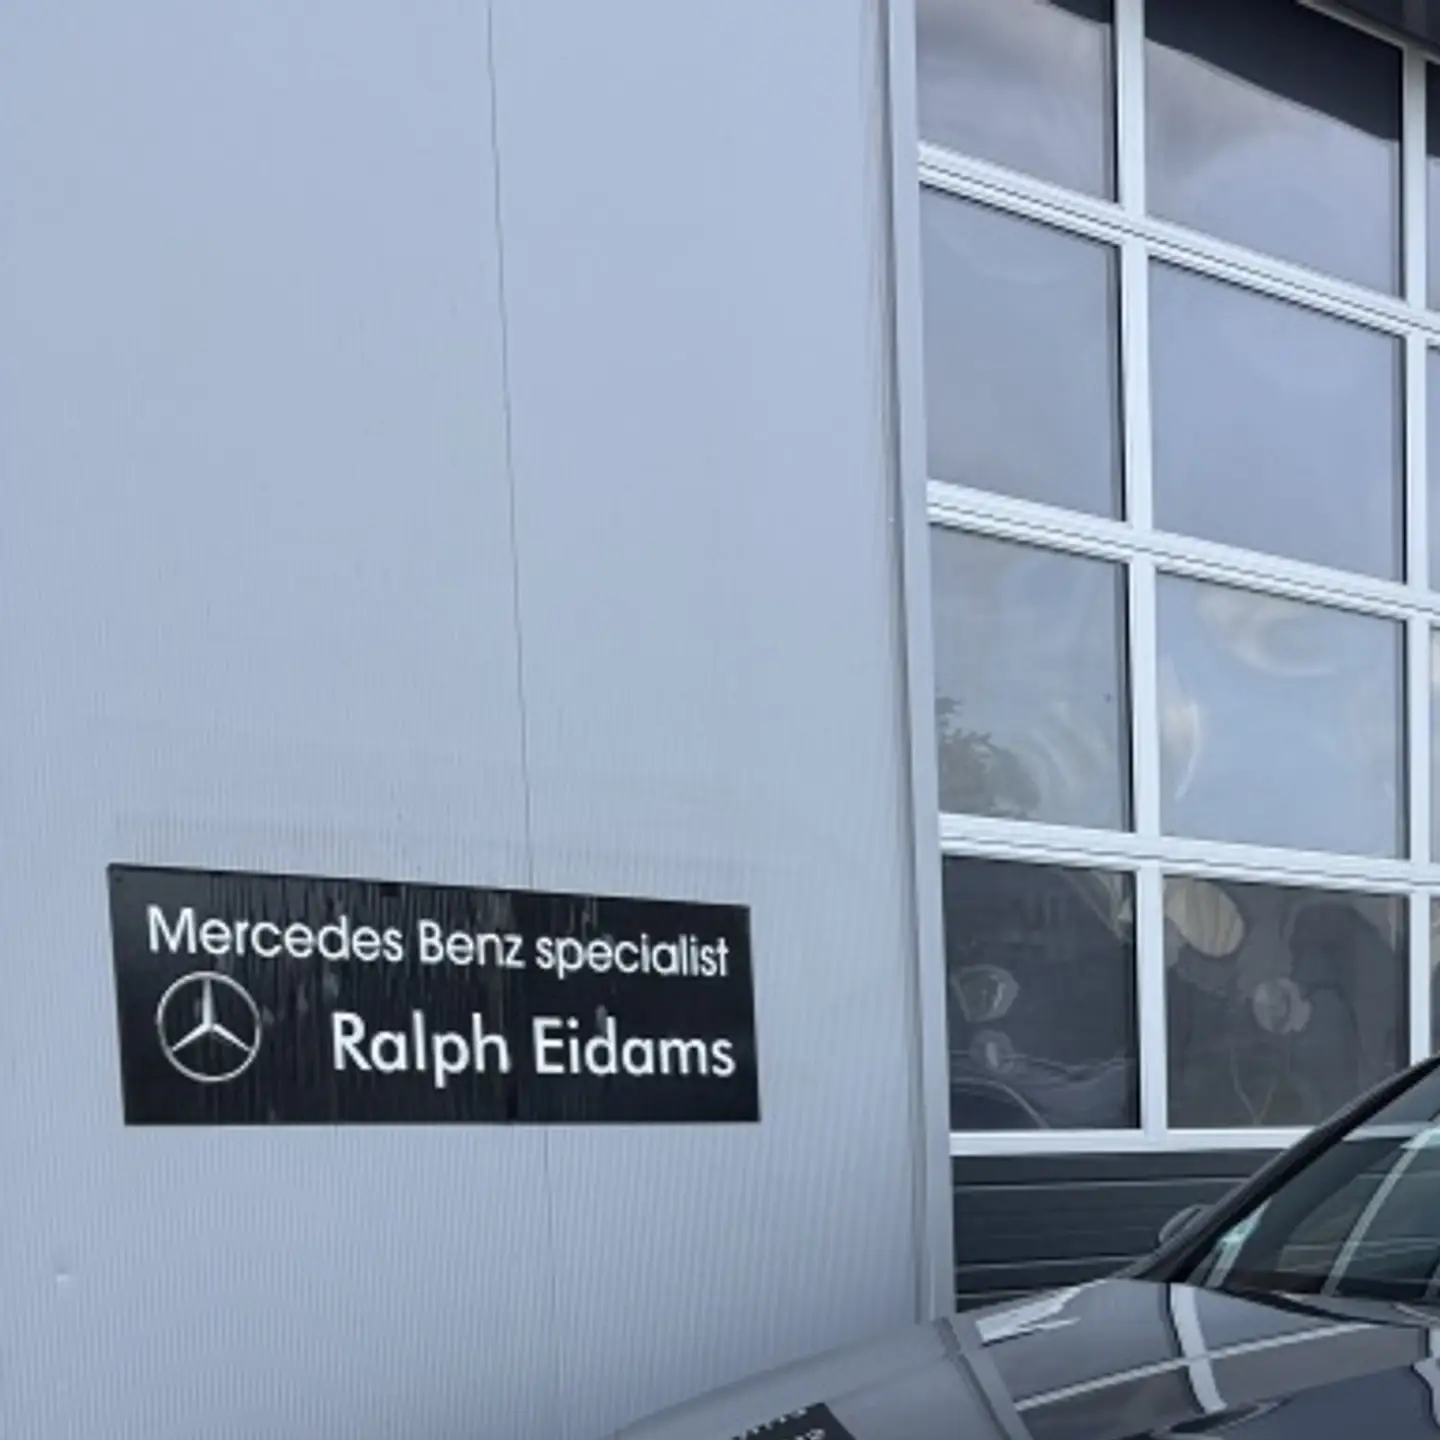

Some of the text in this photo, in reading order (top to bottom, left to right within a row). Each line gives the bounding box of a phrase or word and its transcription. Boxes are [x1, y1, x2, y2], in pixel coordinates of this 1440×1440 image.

[147, 904, 730, 979] Mercedes Benz specialist
[331, 1010, 736, 1088] Ralph Eidams
